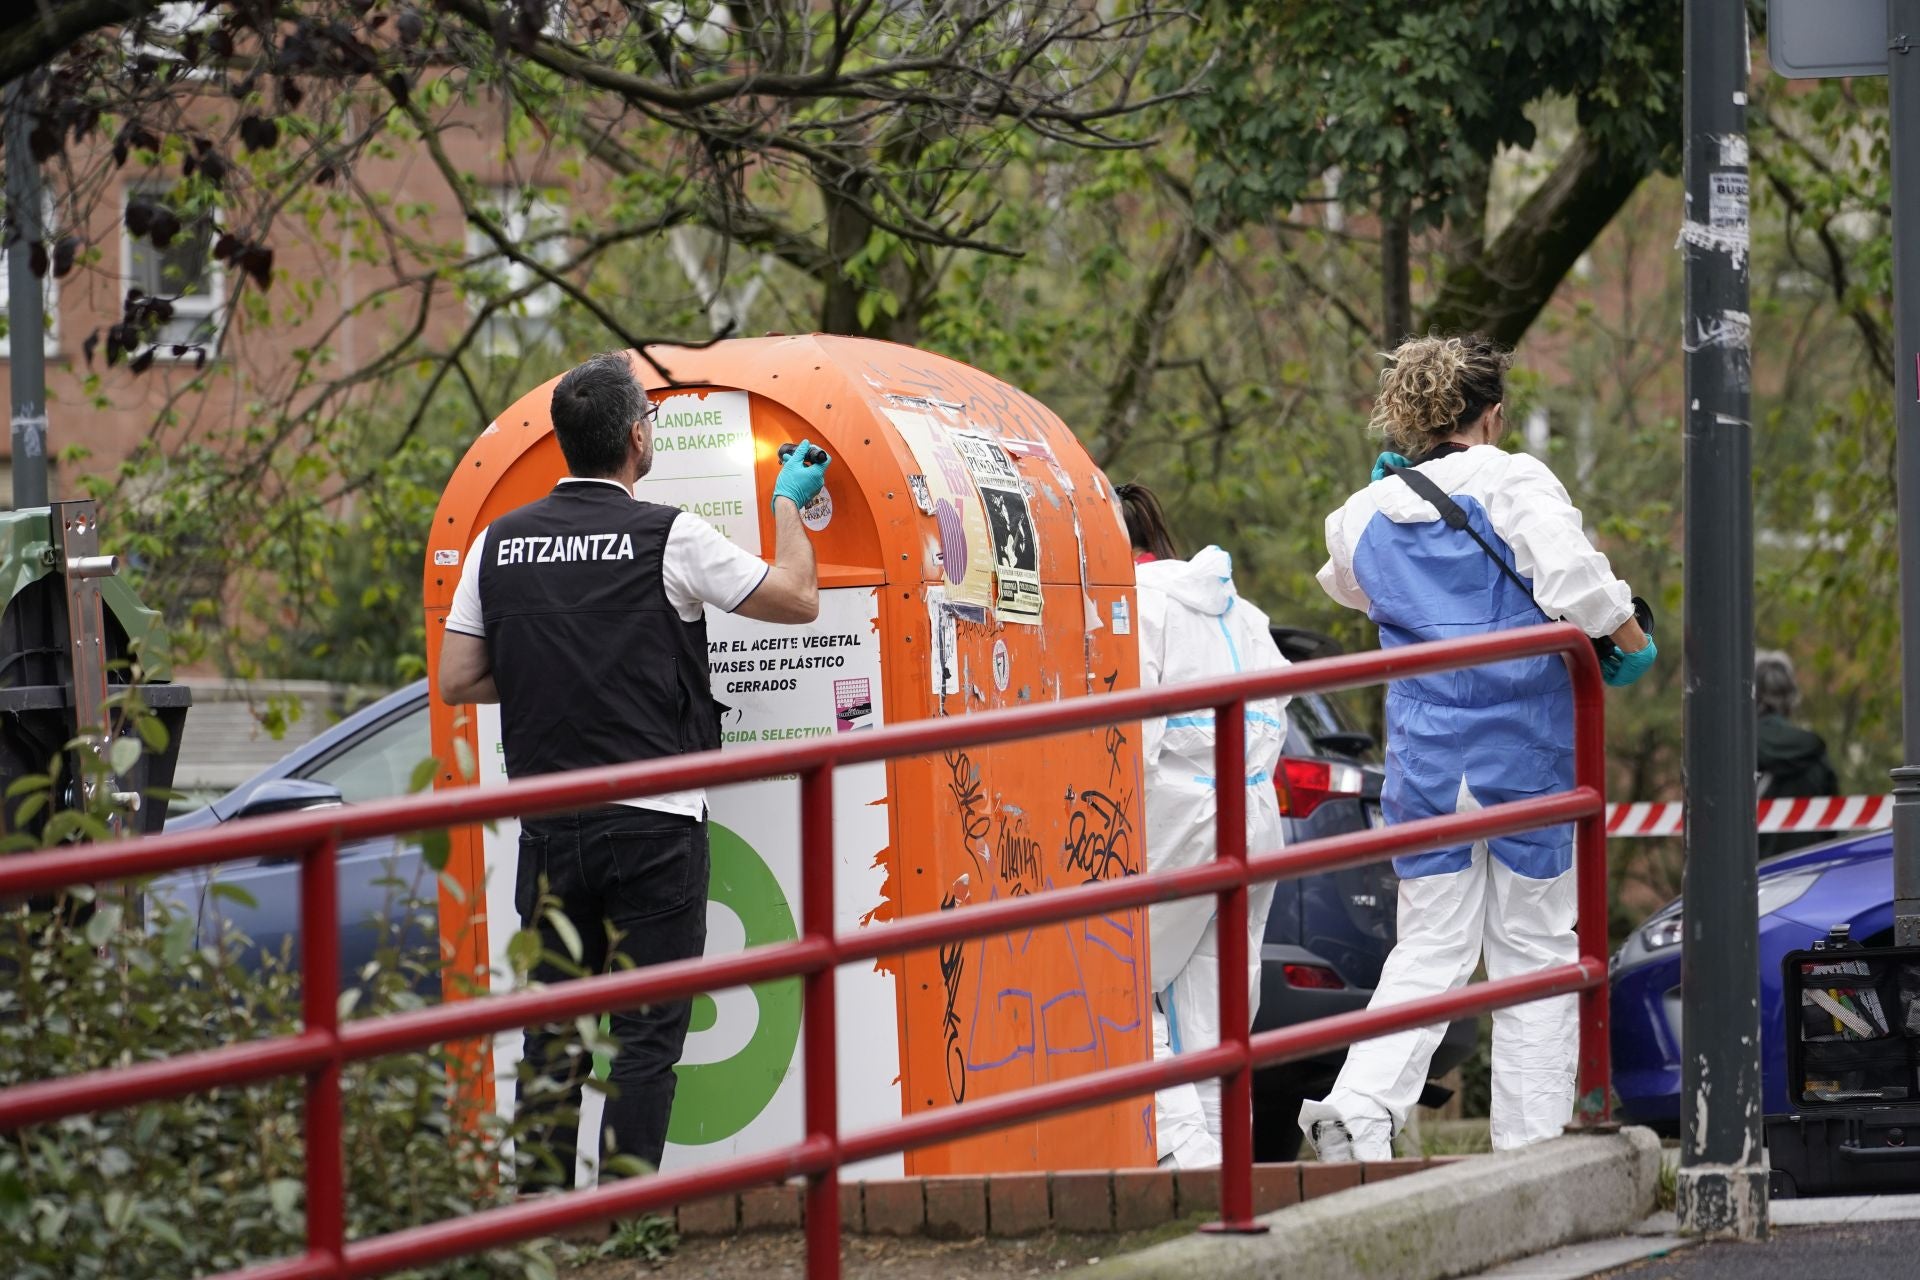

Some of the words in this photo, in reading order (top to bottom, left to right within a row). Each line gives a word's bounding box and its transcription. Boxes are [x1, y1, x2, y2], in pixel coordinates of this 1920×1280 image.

[656, 411, 723, 429] LANDARE
[653, 436, 675, 451] OA
[693, 500, 743, 517] ACEITE
[497, 533, 634, 566] ERTZAINTZA
[732, 640, 748, 652] EL
[751, 637, 798, 651] ACEITE
[802, 634, 861, 649] VEGETAL
[759, 659, 776, 671] DE
[780, 655, 845, 670] PLÁSTICO
[726, 678, 797, 693] CERRADOS
[761, 727, 832, 741] SELECTIVA
